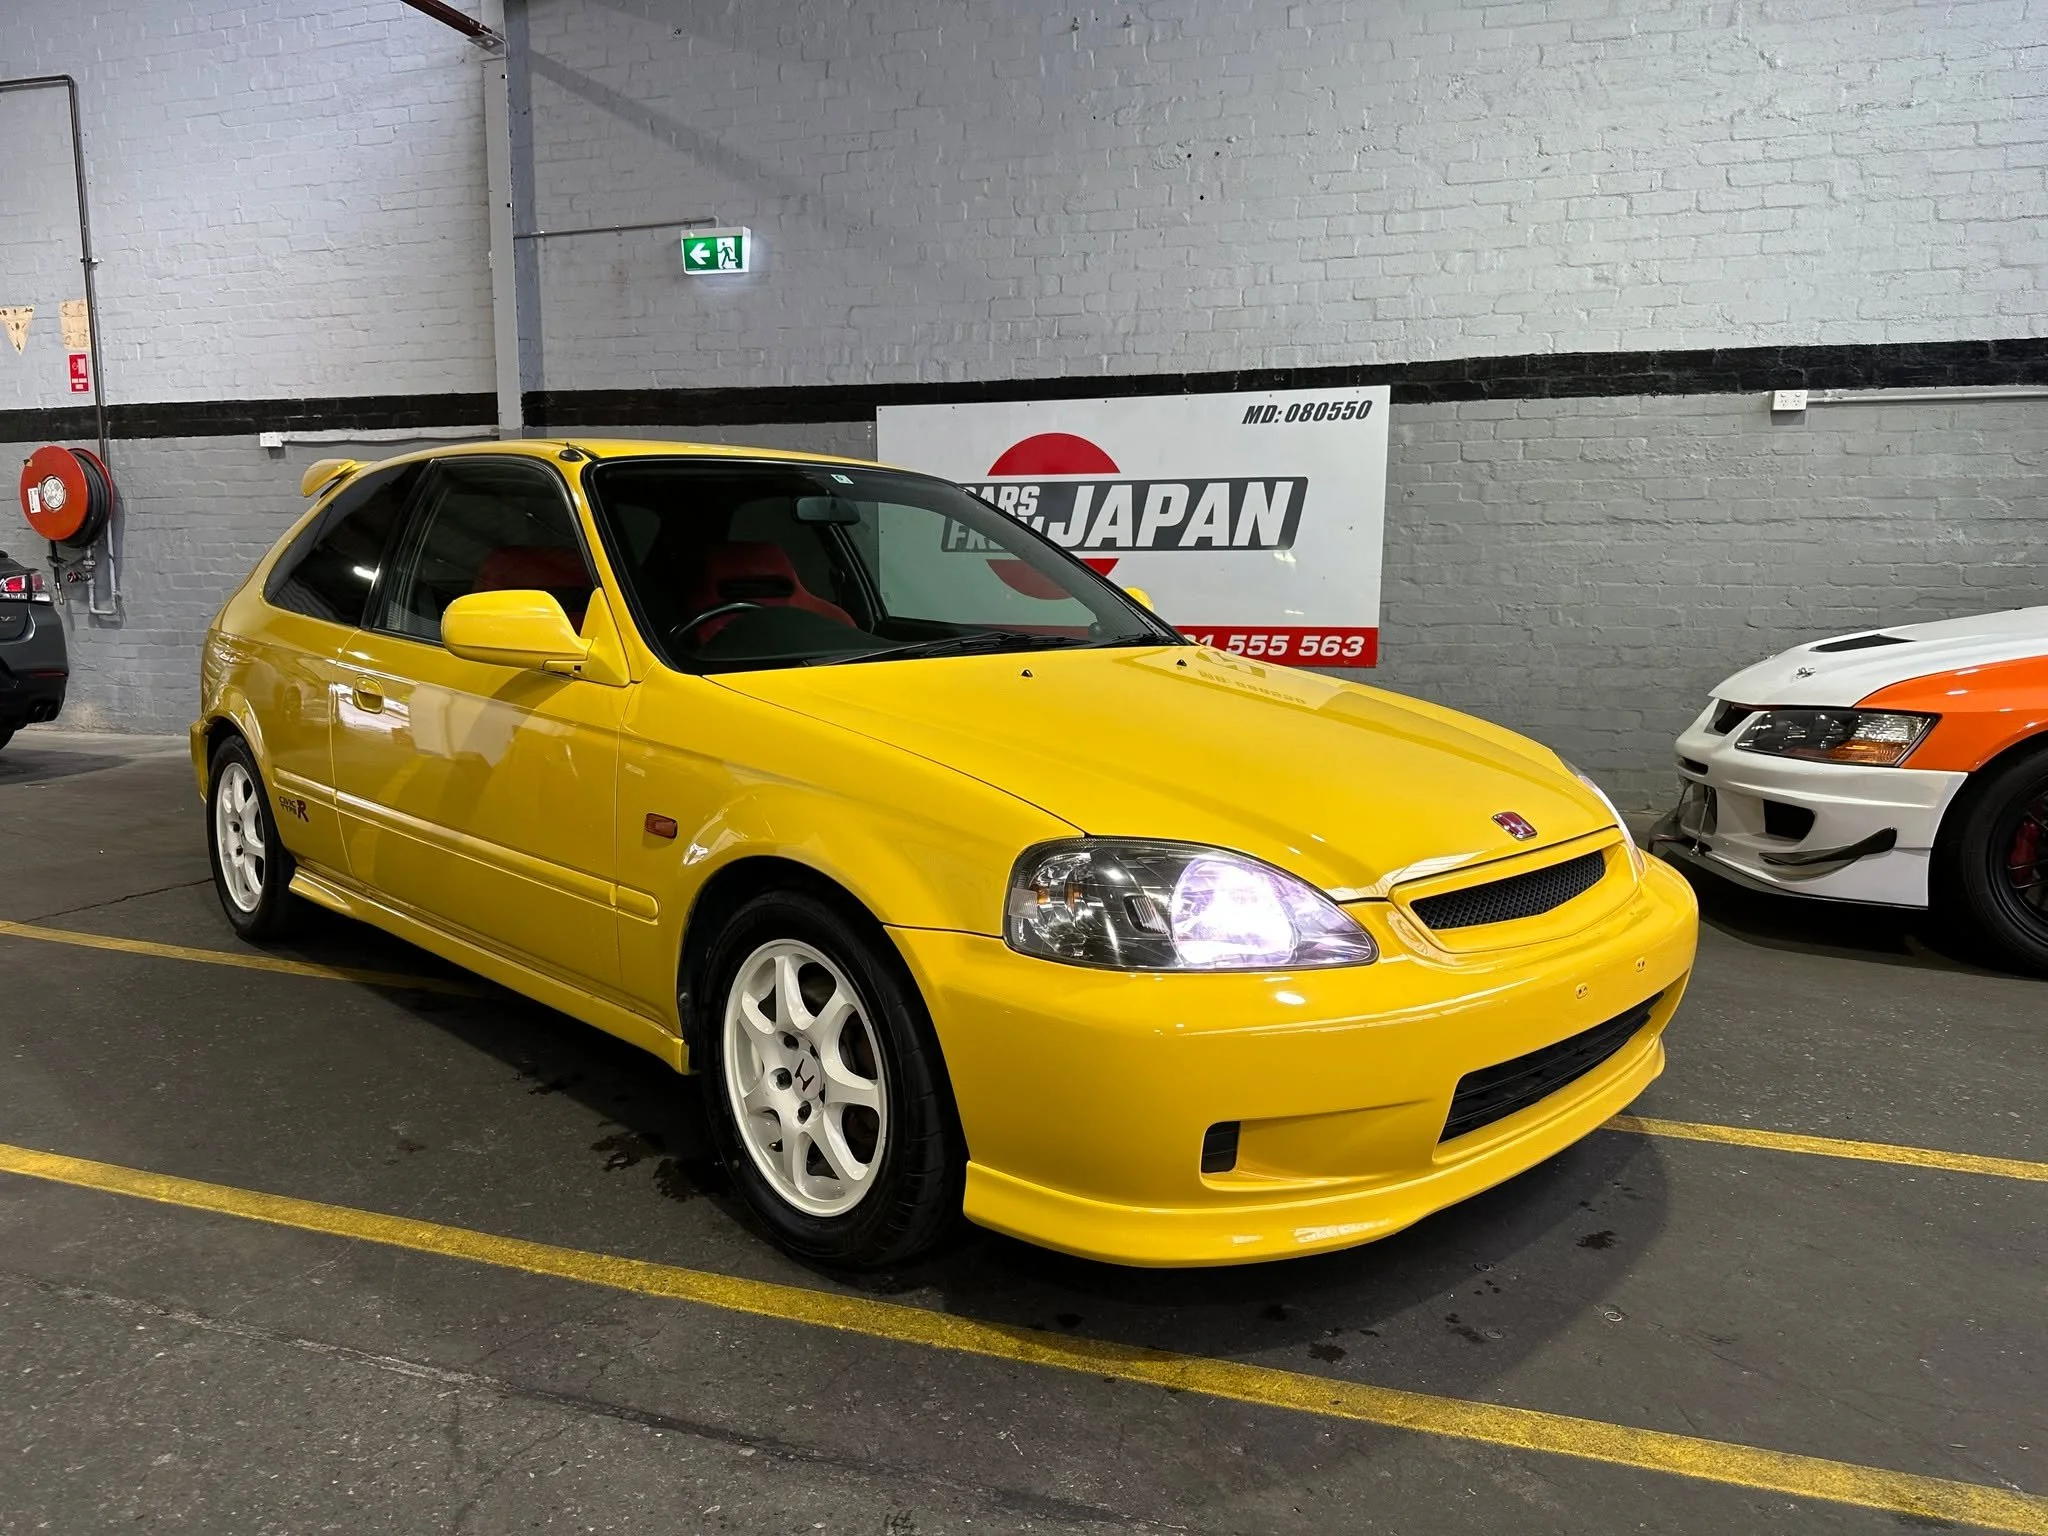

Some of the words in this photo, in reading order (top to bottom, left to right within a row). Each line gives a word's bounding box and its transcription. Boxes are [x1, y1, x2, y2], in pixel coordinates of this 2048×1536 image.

[1242, 404, 1282, 424] MD:
[1284, 400, 1373, 422] 080550
[962, 485, 1041, 517] ARS
[1047, 481, 1294, 548] JAPAN
[1226, 634, 1290, 656] 555
[1298, 635, 1365, 657] 563
[297, 799, 310, 823] R
